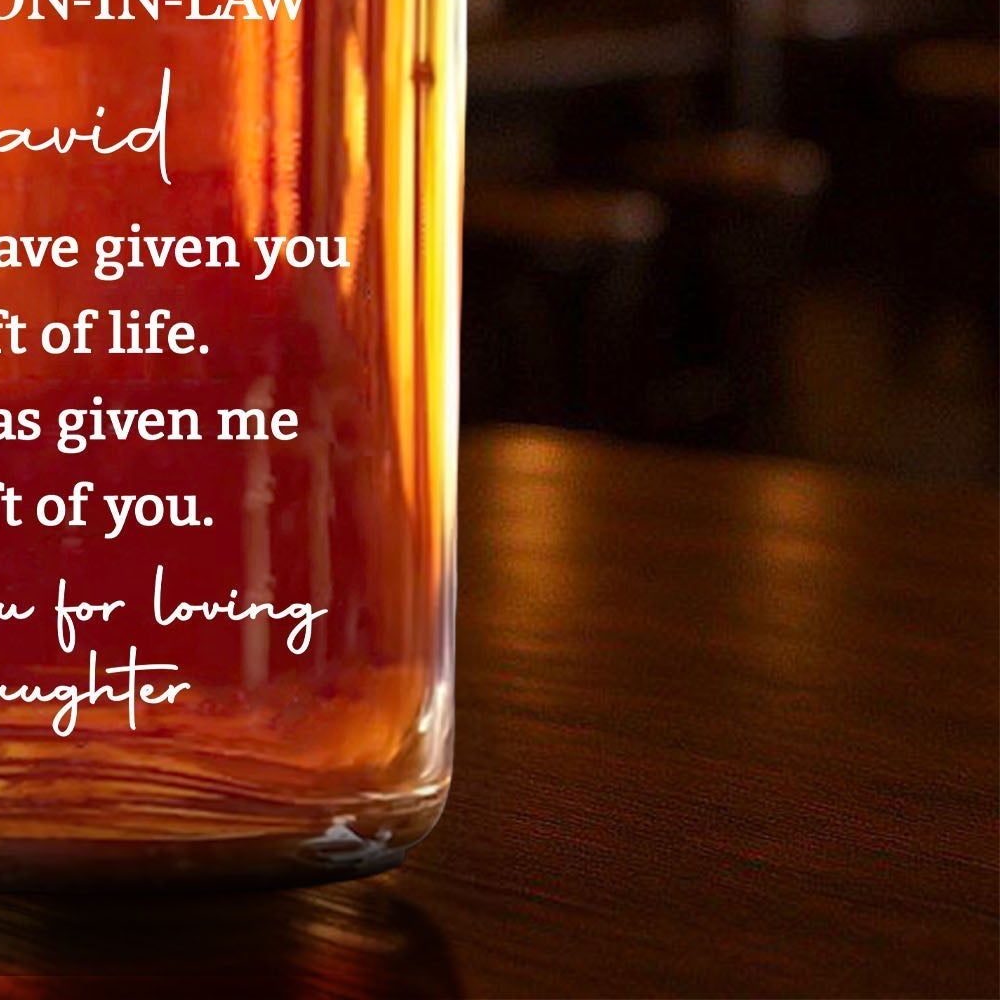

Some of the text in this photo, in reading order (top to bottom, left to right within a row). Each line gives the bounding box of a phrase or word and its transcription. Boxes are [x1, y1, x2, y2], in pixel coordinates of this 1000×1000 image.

[94, 223, 241, 281] given
[253, 235, 351, 281] you
[41, 308, 99, 355] of
[108, 308, 209, 355] life.
[57, 396, 203, 454] given
[217, 408, 299, 441] me
[36, 481, 94, 527] of
[103, 494, 213, 540] you.
[54, 578, 126, 653] for
[153, 564, 329, 655] loving
